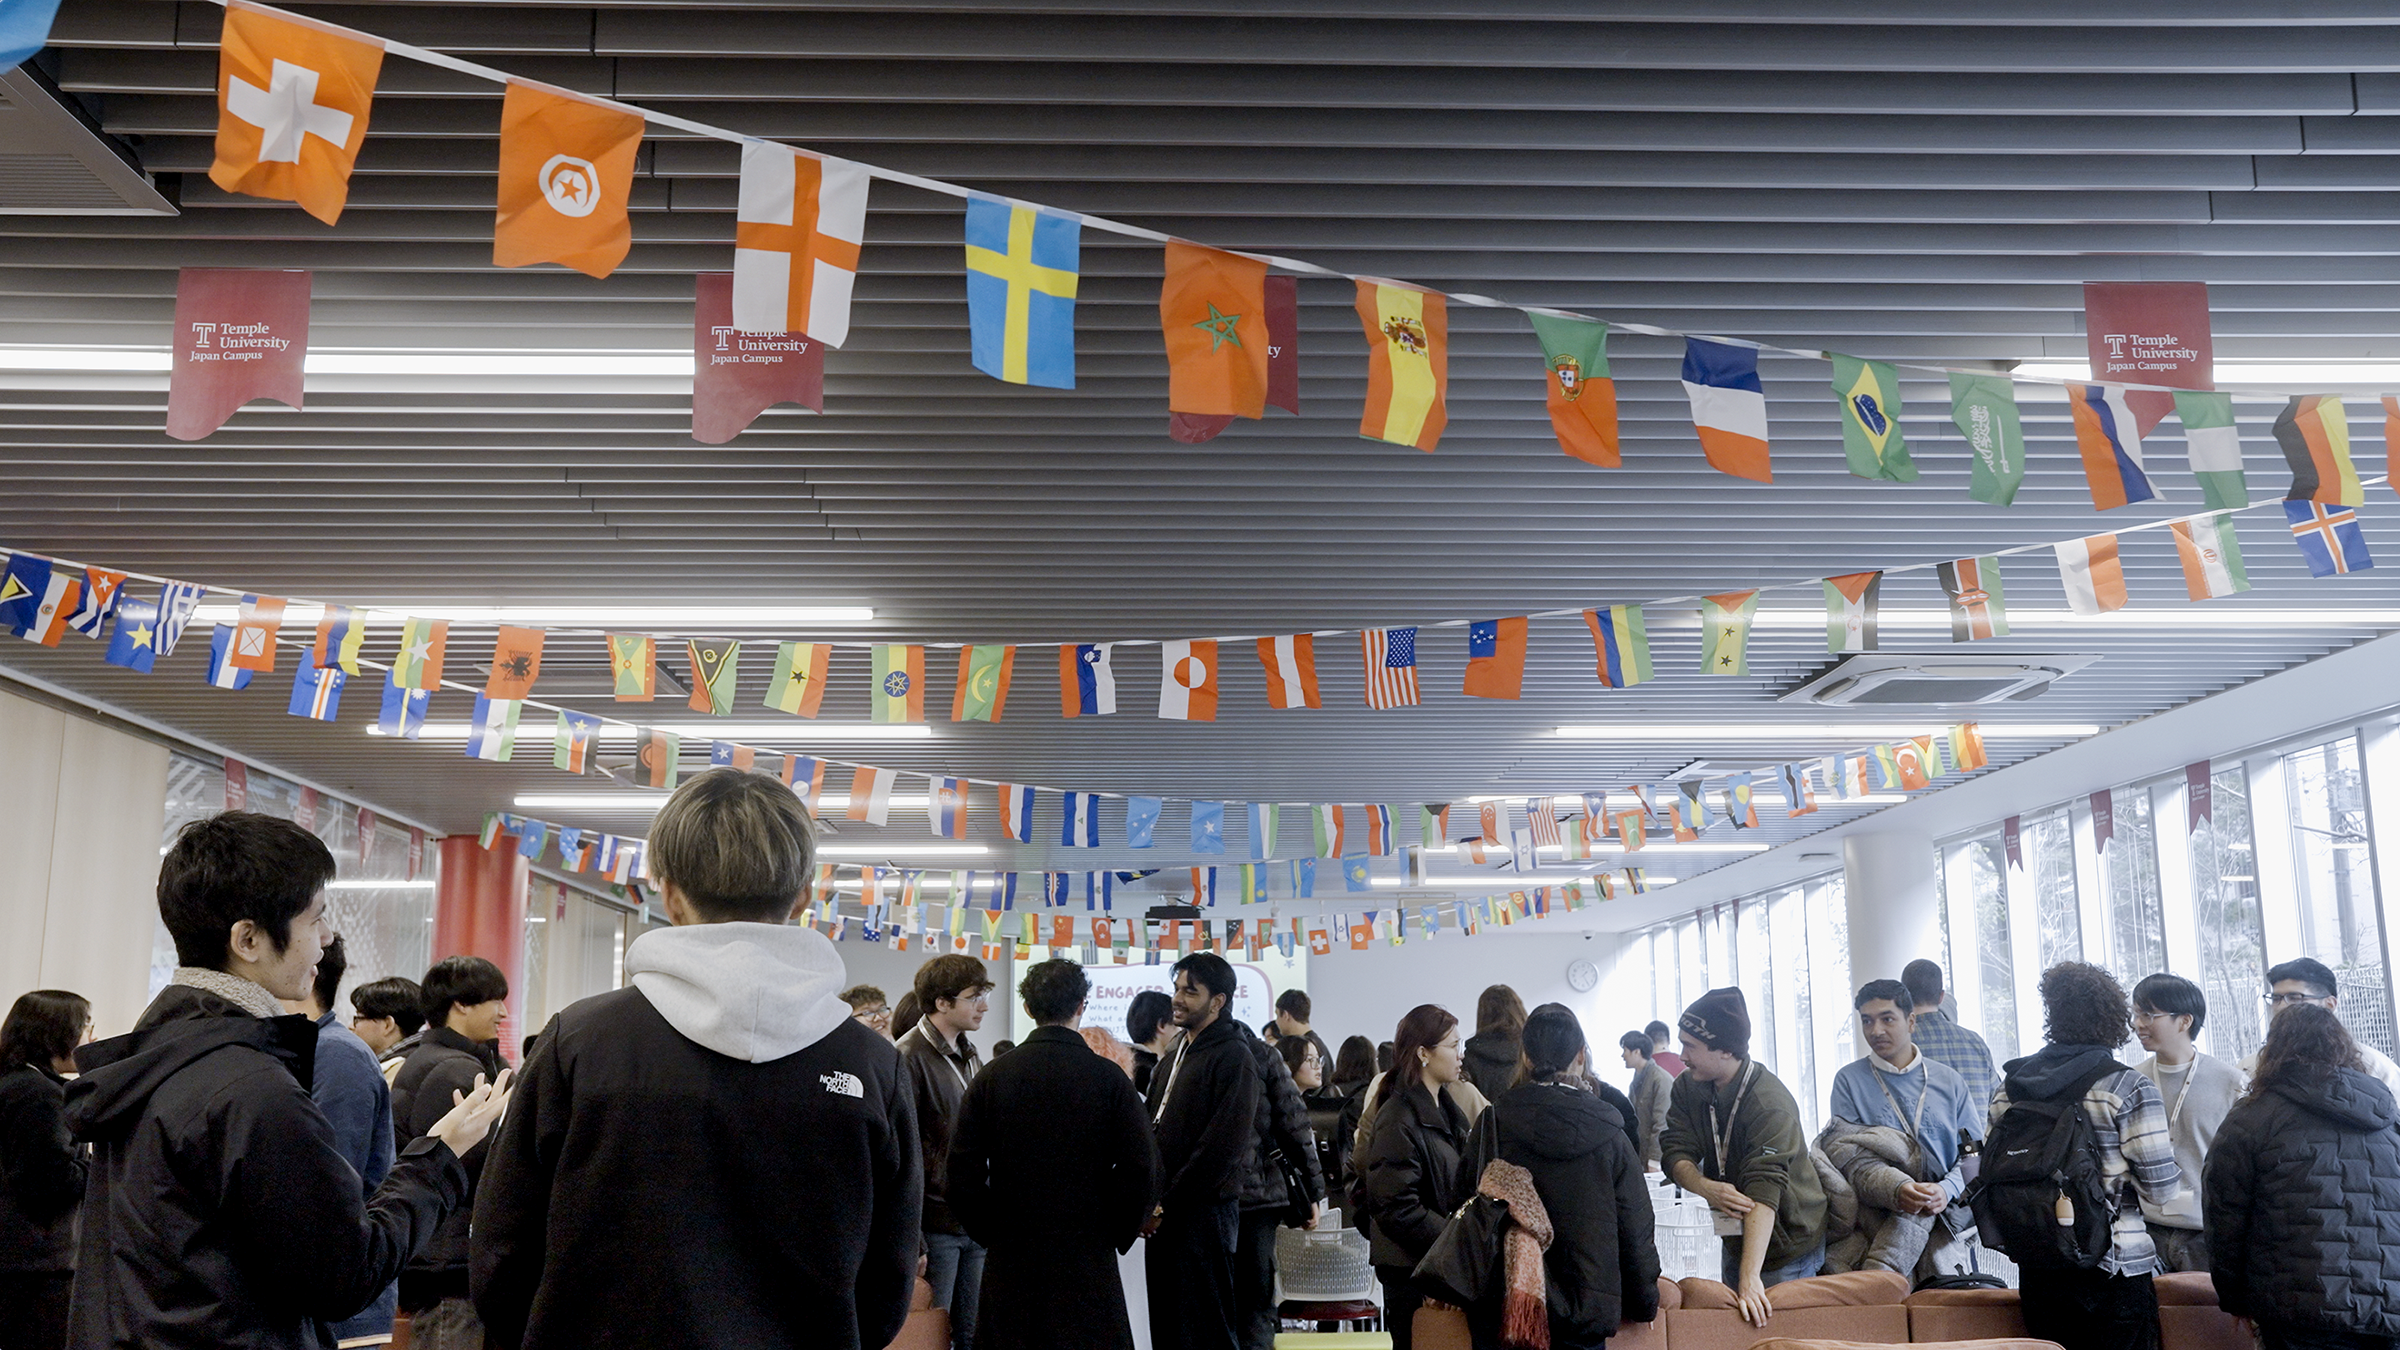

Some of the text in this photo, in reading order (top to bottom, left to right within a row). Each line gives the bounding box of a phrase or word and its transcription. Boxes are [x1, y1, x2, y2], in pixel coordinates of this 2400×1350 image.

[220, 322, 270, 337] Temple
[220, 336, 290, 351] University
[738, 339, 808, 354] University
[2130, 334, 2178, 348] Temple
[189, 351, 263, 362] Japan Campus
[710, 354, 783, 365] Japan Campus
[2131, 347, 2198, 362] University
[2106, 361, 2177, 373] Japan Campus
[1089, 1004, 1118, 1012] Where
[820, 1074, 850, 1089] NORTH
[833, 1070, 851, 1081] THE
[826, 1084, 849, 1095] FACE
